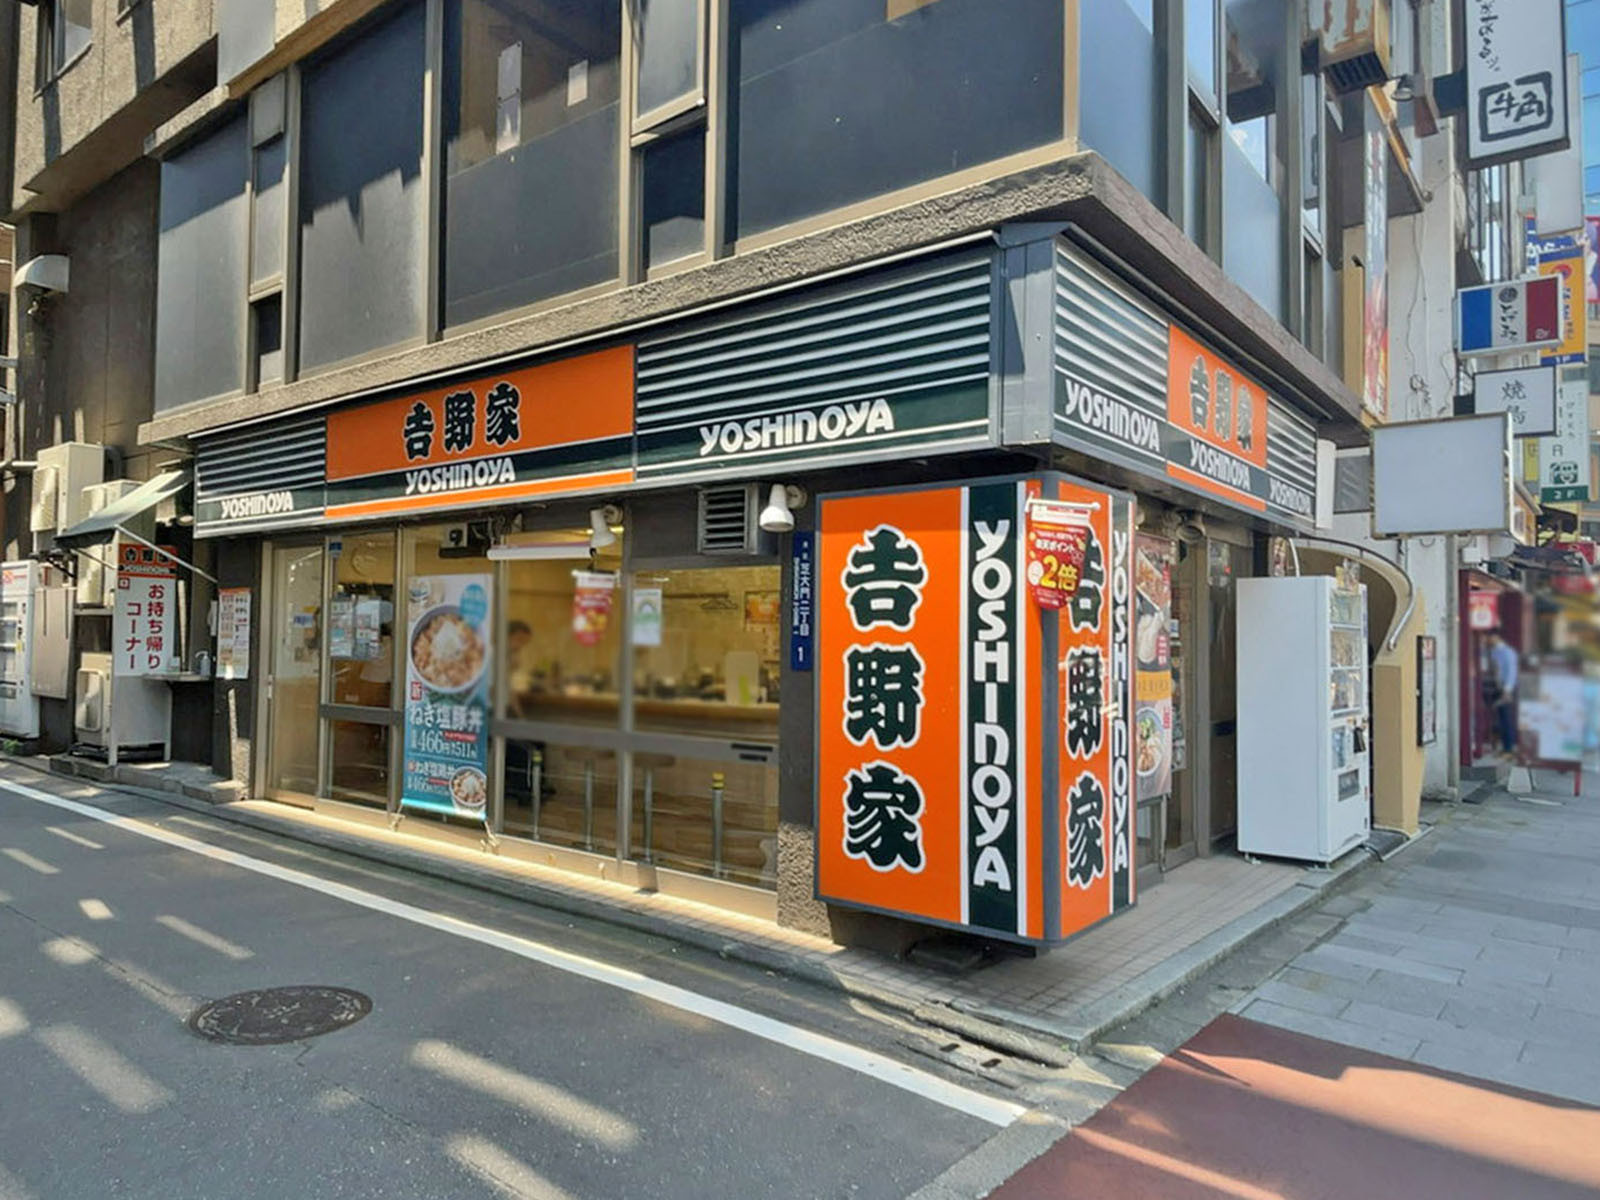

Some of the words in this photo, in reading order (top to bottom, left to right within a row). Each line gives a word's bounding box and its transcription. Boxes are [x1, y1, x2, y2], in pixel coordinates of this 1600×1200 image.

[1489, 91, 1545, 122] 牛角
[404, 382, 520, 461] 吉野家
[700, 399, 894, 456] YOSHINOYA
[1065, 379, 1160, 451] YOSHINOYA
[405, 458, 515, 495] YOSHINOYA
[1189, 439, 1250, 491] YOSHINOYA
[221, 491, 293, 518] YOSHINOYA
[1040, 554, 1078, 590] 2倍
[126, 602, 141, 669] コーナー
[146, 584, 165, 669] お持ち帰り
[842, 525, 927, 873] 吉野家
[972, 519, 1012, 892] YOSHINOYA
